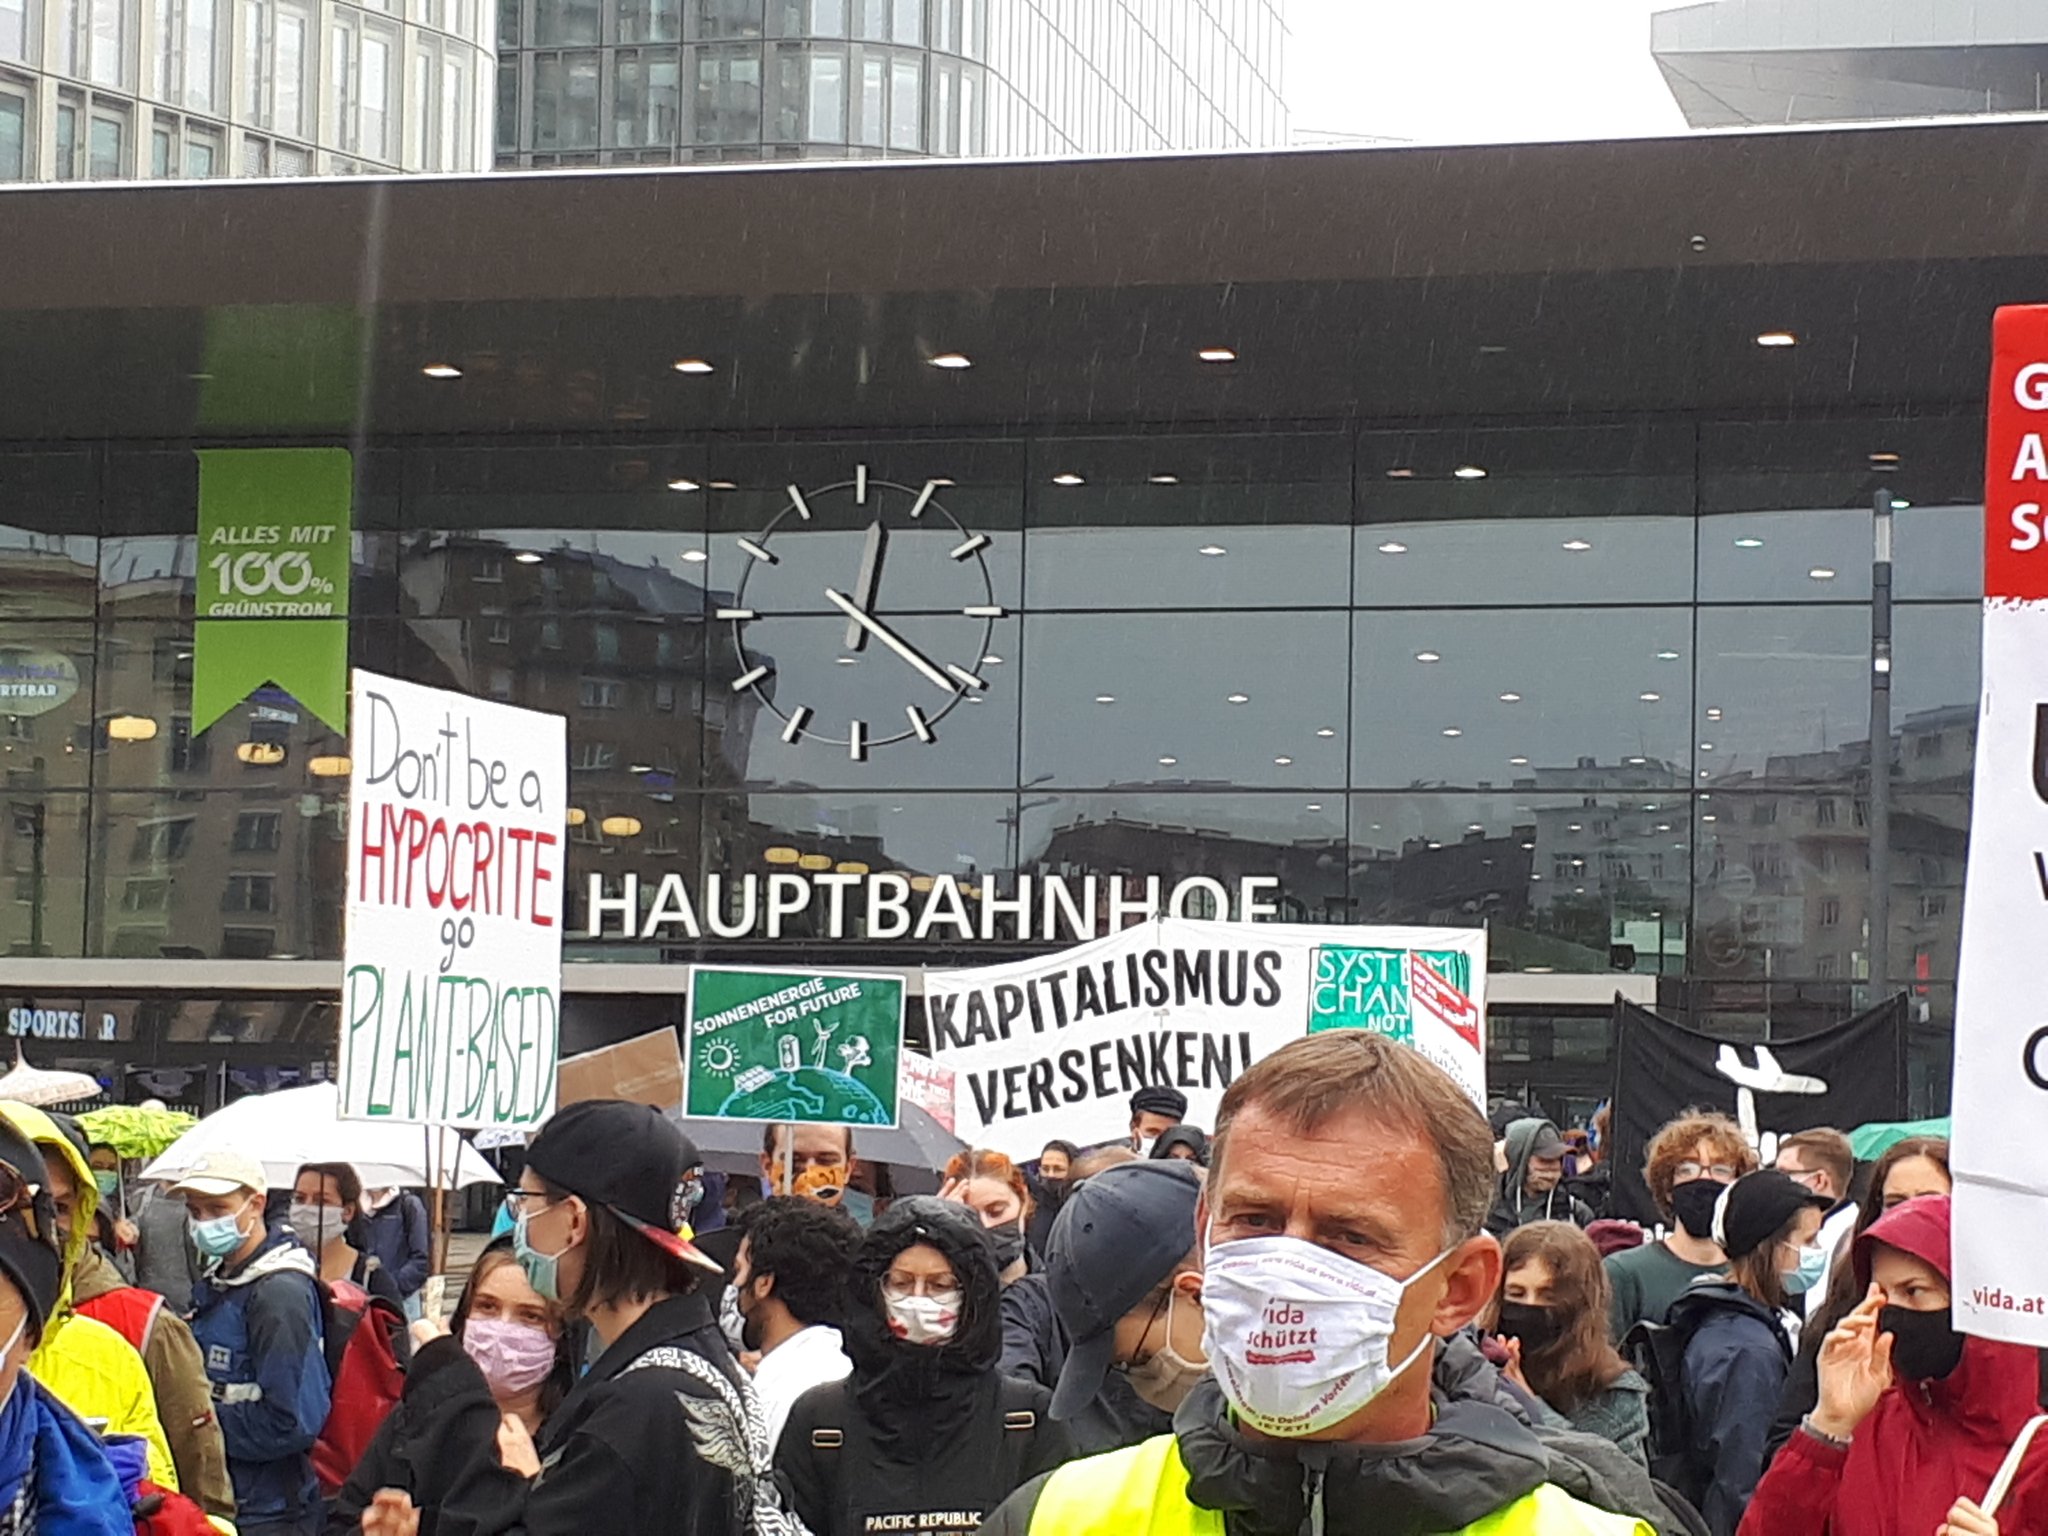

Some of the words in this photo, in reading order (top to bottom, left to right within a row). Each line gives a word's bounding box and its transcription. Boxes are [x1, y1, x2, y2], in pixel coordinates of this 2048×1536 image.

[209, 525, 281, 545] ALLES
[289, 525, 336, 544] MIT
[2010, 502, 2048, 551] S
[208, 550, 334, 596] 100%
[208, 599, 333, 617] GRÜNSTROM
[366, 691, 459, 806] Don't
[466, 717, 508, 810] be
[519, 770, 543, 813] a
[359, 801, 557, 927] HYPOCRITE
[588, 873, 1279, 940] HAUPTBAHNHOF
[439, 916, 475, 973] go
[7, 1007, 116, 1040] SPORTSR
[694, 977, 826, 1036] SONNENENERGIE
[764, 1005, 799, 1029] FOR
[799, 982, 862, 1017] FUTURE
[929, 949, 1282, 1051] KAPITALISMUS
[344, 964, 557, 1124] PLANT-BASED
[967, 1031, 1250, 1127] VERSENKEN!
[1973, 1286, 2045, 1314] vida.at
[866, 1514, 915, 1530] PACIFIC
[919, 1512, 982, 1528] REPUBLIC
